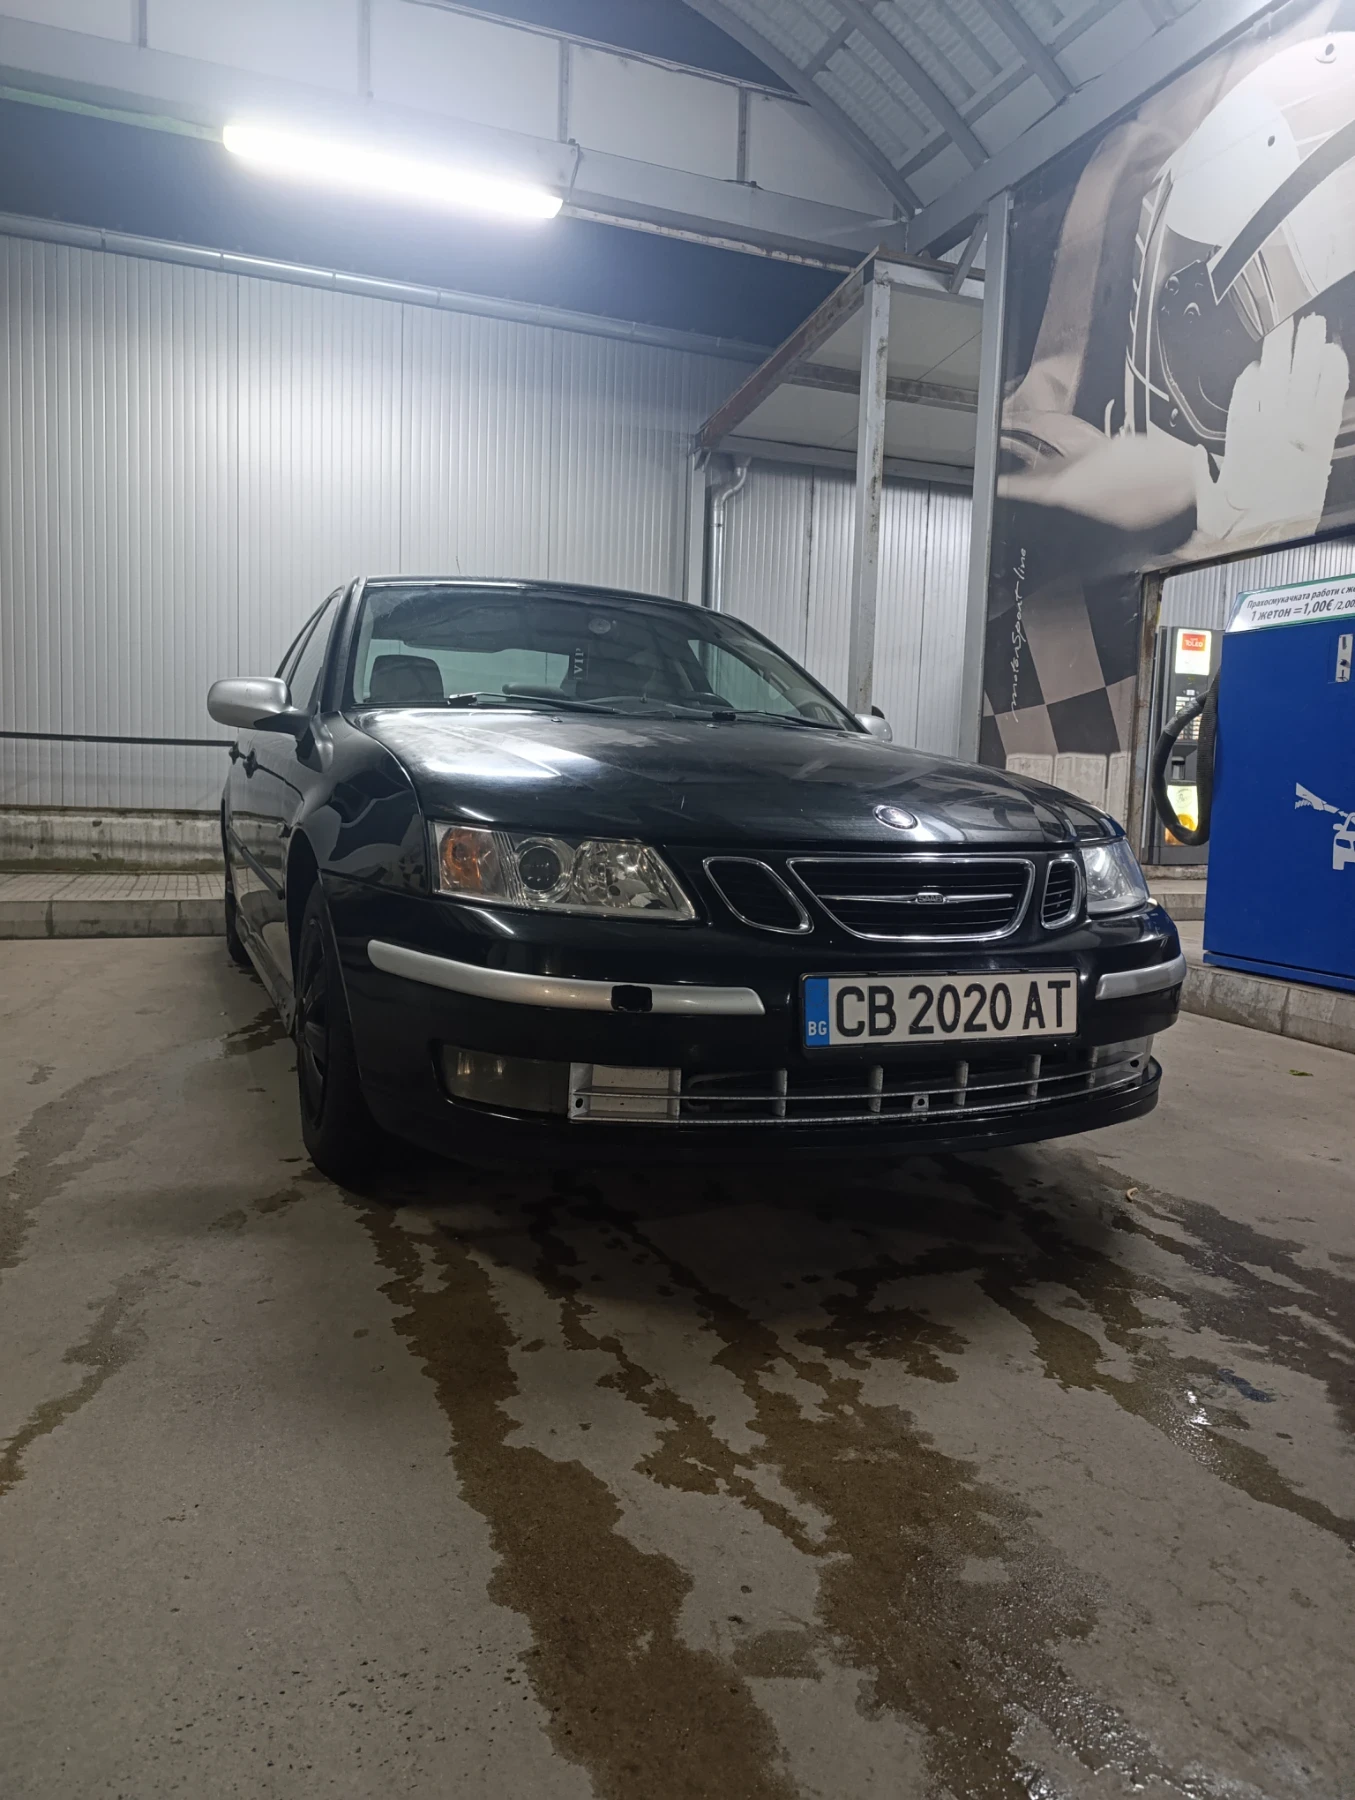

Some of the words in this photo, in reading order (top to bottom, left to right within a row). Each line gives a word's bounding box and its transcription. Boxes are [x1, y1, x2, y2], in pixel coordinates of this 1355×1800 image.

[1013, 548, 1027, 580] line
[1247, 594, 1310, 609] Прахосмукачката
[1310, 587, 1340, 600] работи
[1251, 610, 1257, 621] 1
[1257, 607, 1292, 621] жетон
[807, 1020, 827, 1036] BG
[835, 985, 897, 1037] CB
[908, 982, 1012, 1035] 2020
[1022, 980, 1071, 1030] AT
